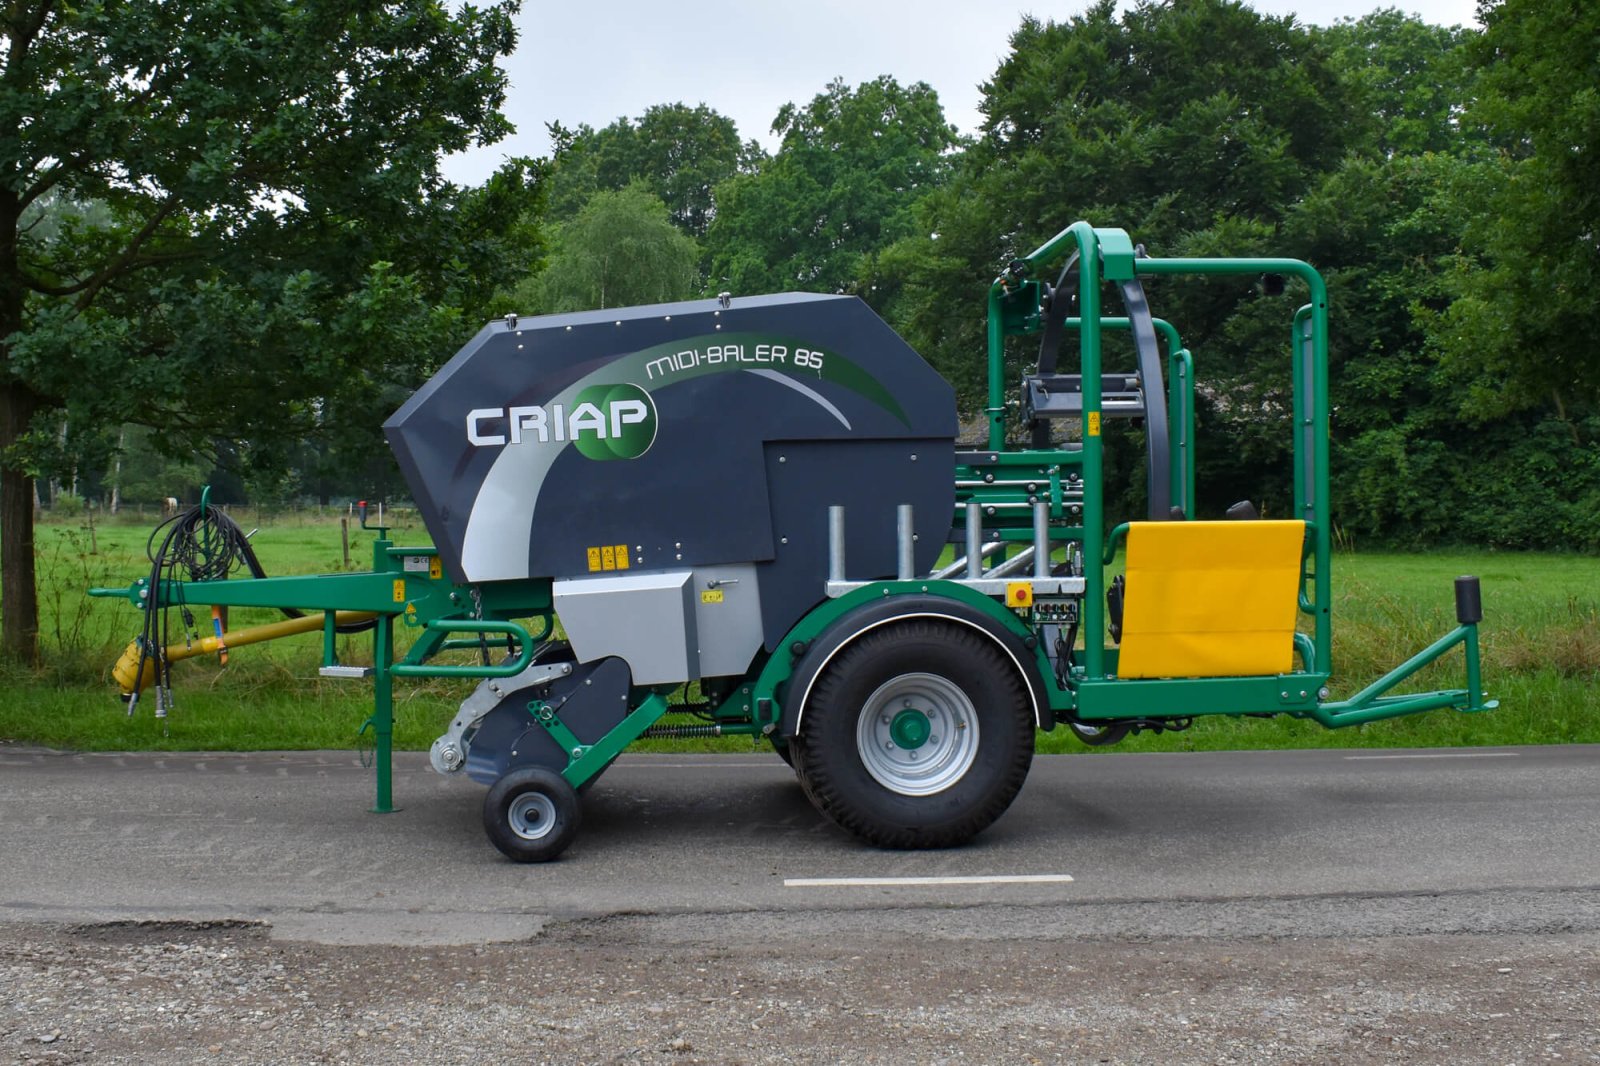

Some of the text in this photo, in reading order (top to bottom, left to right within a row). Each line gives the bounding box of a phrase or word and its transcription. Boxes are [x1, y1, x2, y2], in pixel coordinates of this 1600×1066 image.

[645, 344, 825, 379] MIDI-BALER 85
[466, 400, 648, 447] CRIAP
